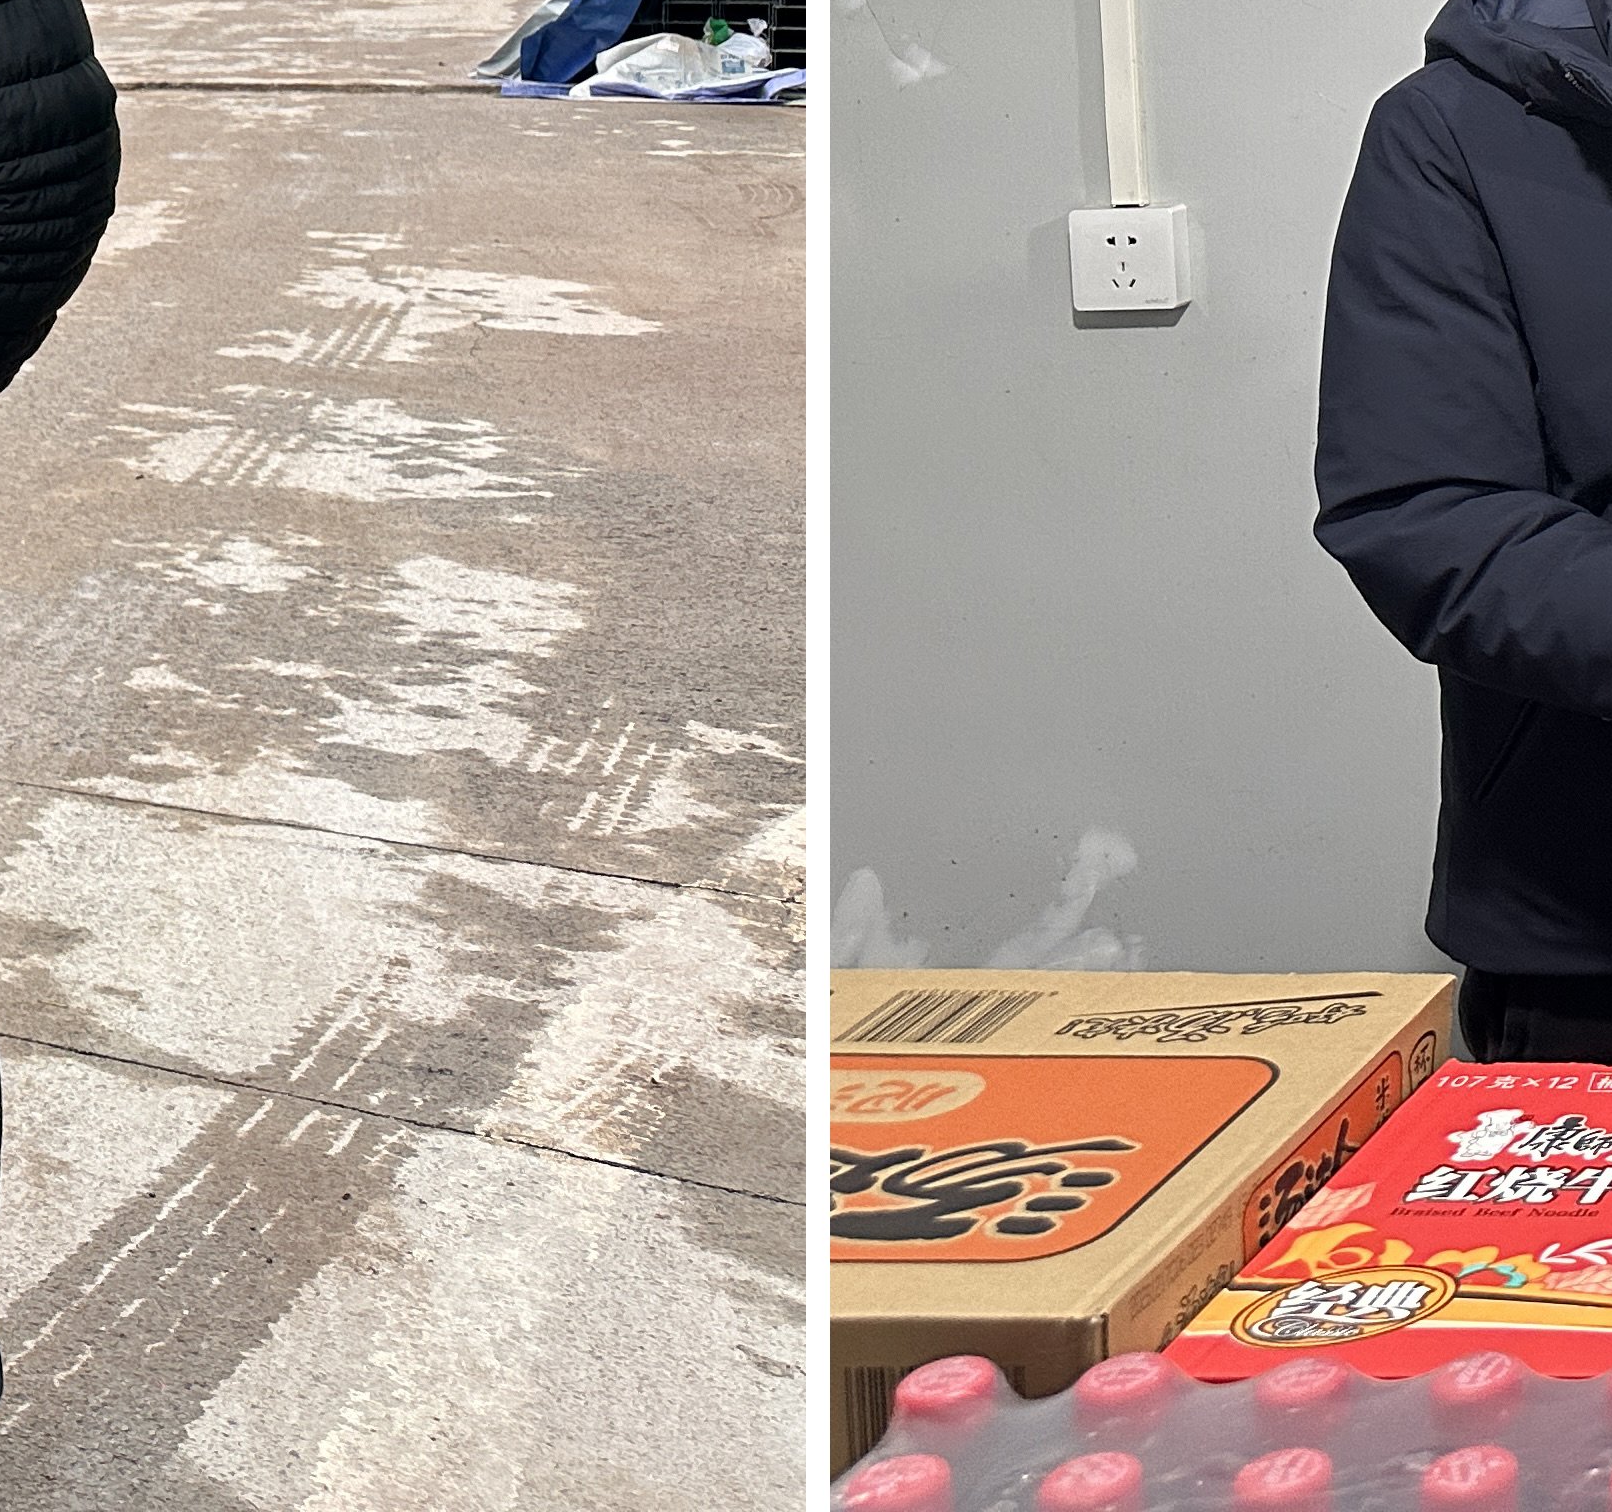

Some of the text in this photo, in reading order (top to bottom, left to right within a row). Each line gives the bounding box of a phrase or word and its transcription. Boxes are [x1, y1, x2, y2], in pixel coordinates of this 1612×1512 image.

[1389, 1207, 1600, 1218] Braised Beef Noodle
[1270, 1280, 1434, 1322] 经典
